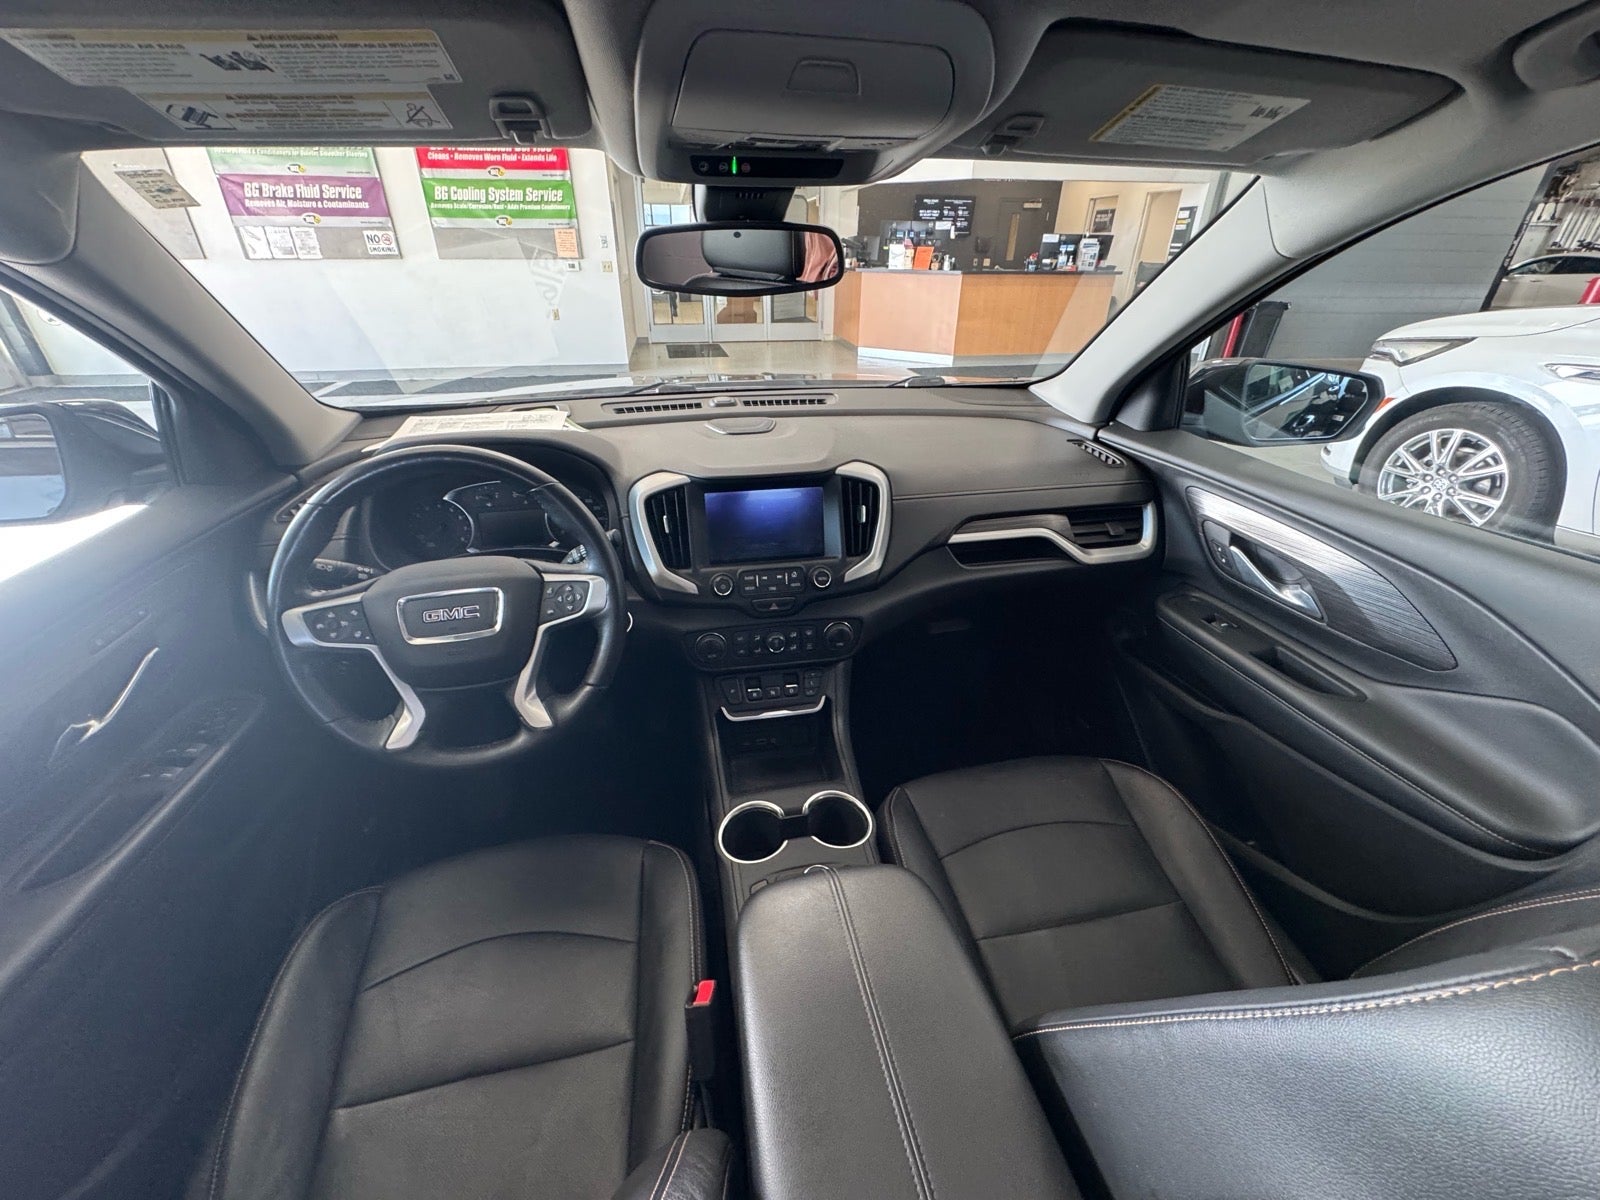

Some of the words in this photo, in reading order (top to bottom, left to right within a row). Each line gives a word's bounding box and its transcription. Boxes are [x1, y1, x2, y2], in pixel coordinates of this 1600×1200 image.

[427, 152, 450, 160] Cleans
[454, 153, 483, 161] Removes
[484, 153, 501, 161] Worn
[502, 153, 517, 161] Fluid
[521, 153, 545, 162] Extends
[546, 154, 557, 162] Life
[243, 182, 260, 197] BG
[262, 183, 293, 198] Brake
[295, 183, 320, 199] Fluid
[322, 184, 362, 199] Service
[434, 186, 448, 200] BG
[450, 186, 486, 204] Cooling
[488, 187, 524, 203] System
[525, 188, 563, 202] Service
[245, 199, 276, 208] Removes
[287, 200, 316, 208] Moisture
[323, 200, 370, 209] Contaminants
[366, 234, 380, 244] NO
[422, 605, 480, 623] GMC
